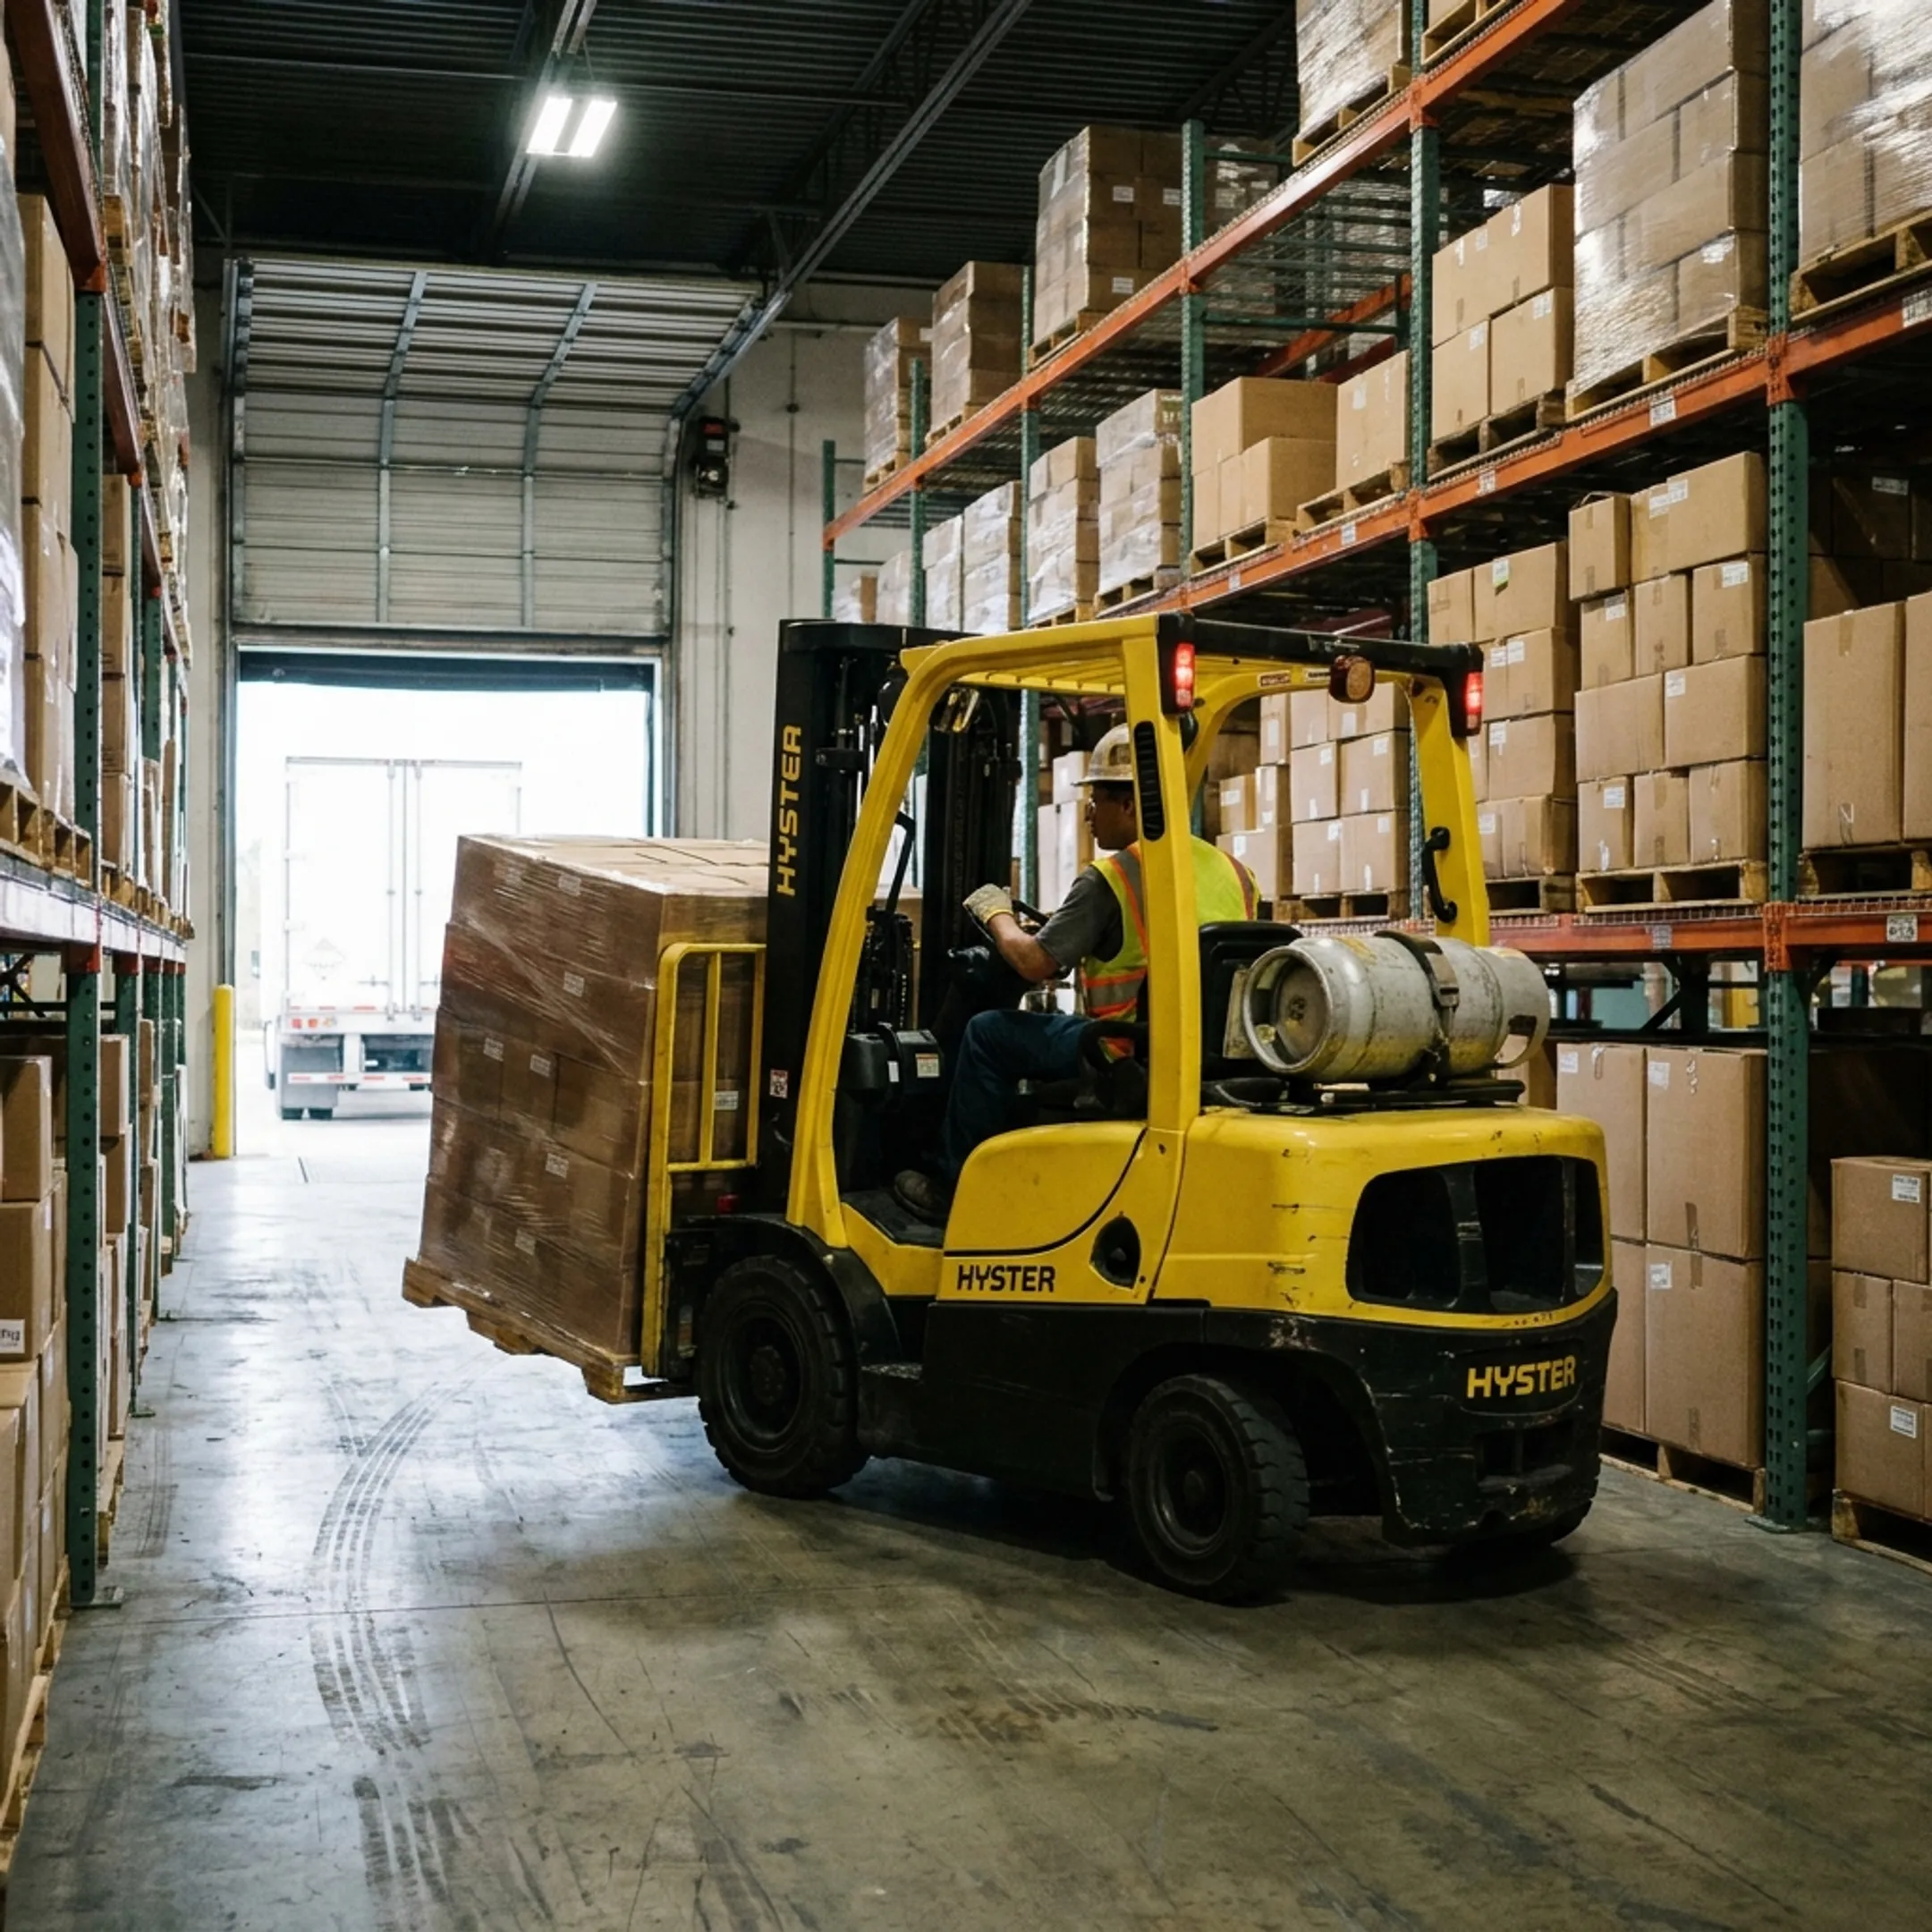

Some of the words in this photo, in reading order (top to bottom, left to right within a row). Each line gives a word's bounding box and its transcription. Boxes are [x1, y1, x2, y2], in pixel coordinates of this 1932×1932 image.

[776, 724, 802, 897] HYSTER
[956, 1264, 1056, 1292] HYSTER
[1467, 1354, 1576, 1398] HYSTER
